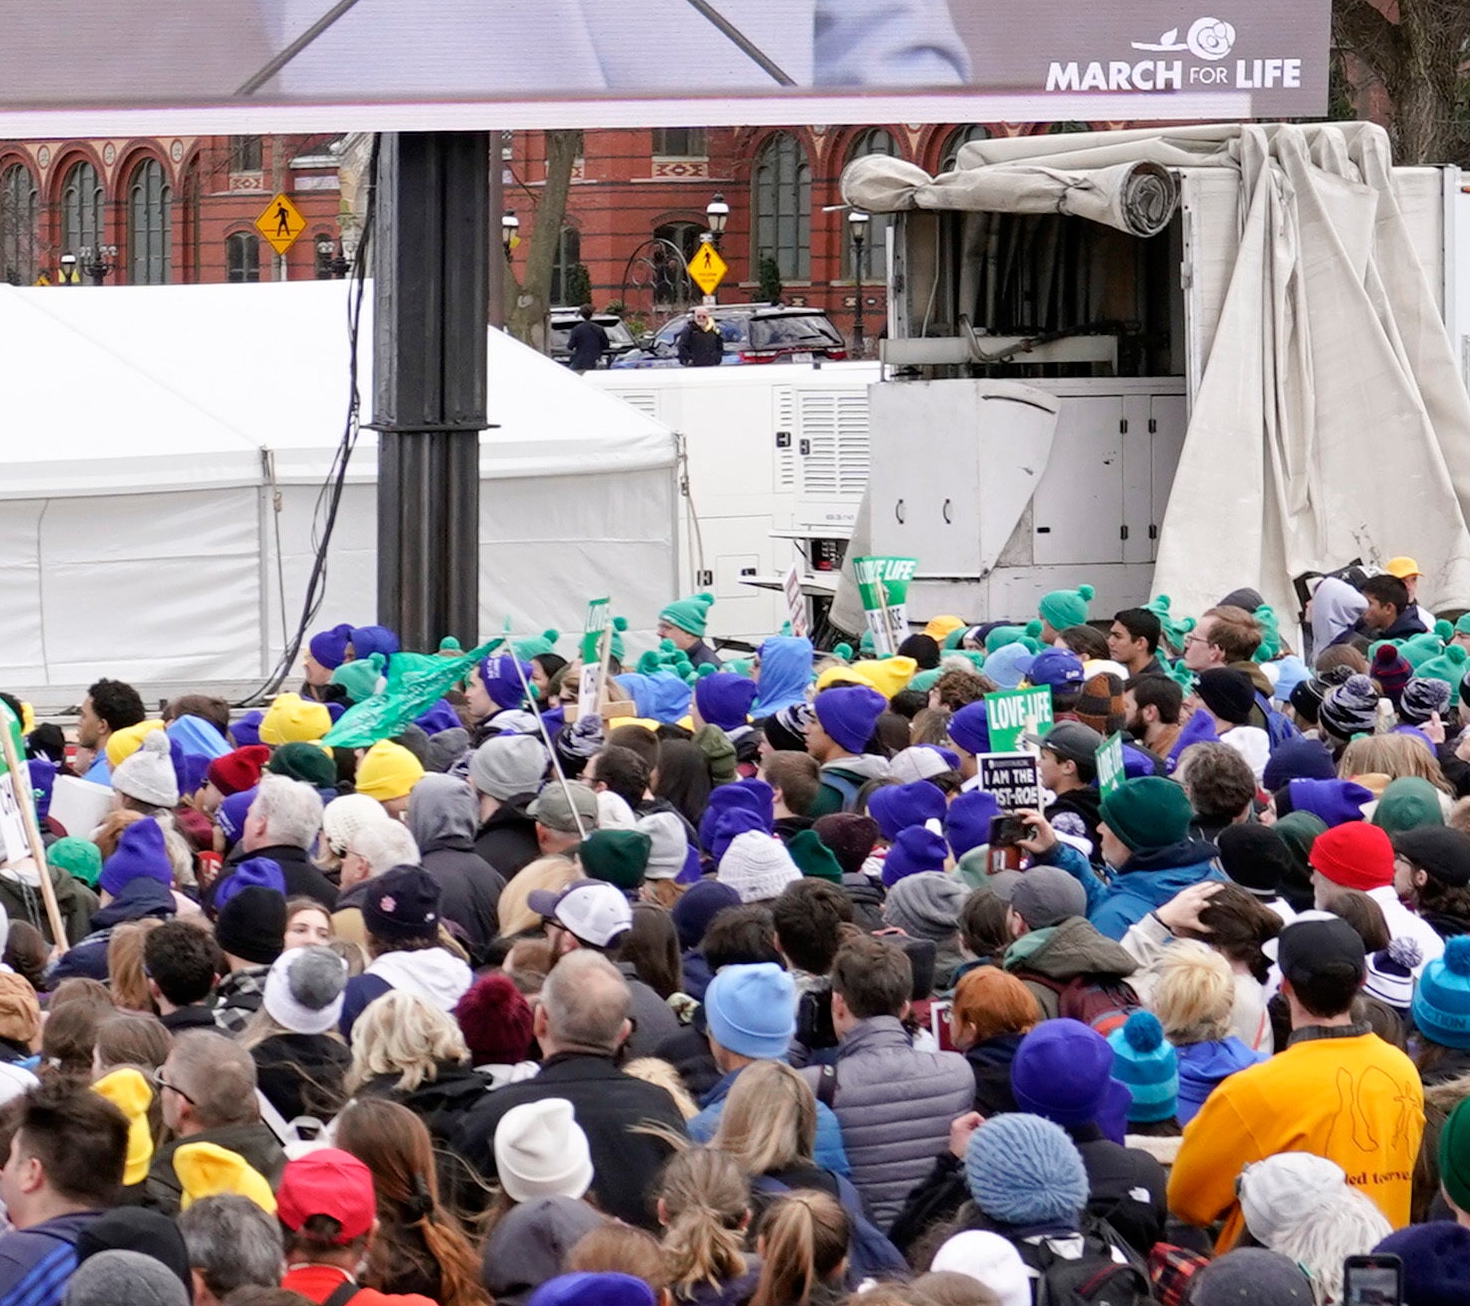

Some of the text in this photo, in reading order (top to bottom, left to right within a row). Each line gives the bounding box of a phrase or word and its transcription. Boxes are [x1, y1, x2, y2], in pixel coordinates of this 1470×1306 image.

[1044, 58, 1302, 92] MARCH FOR LIFE
[989, 695, 1025, 730] LOVE
[984, 768, 1034, 785] I AM THE
